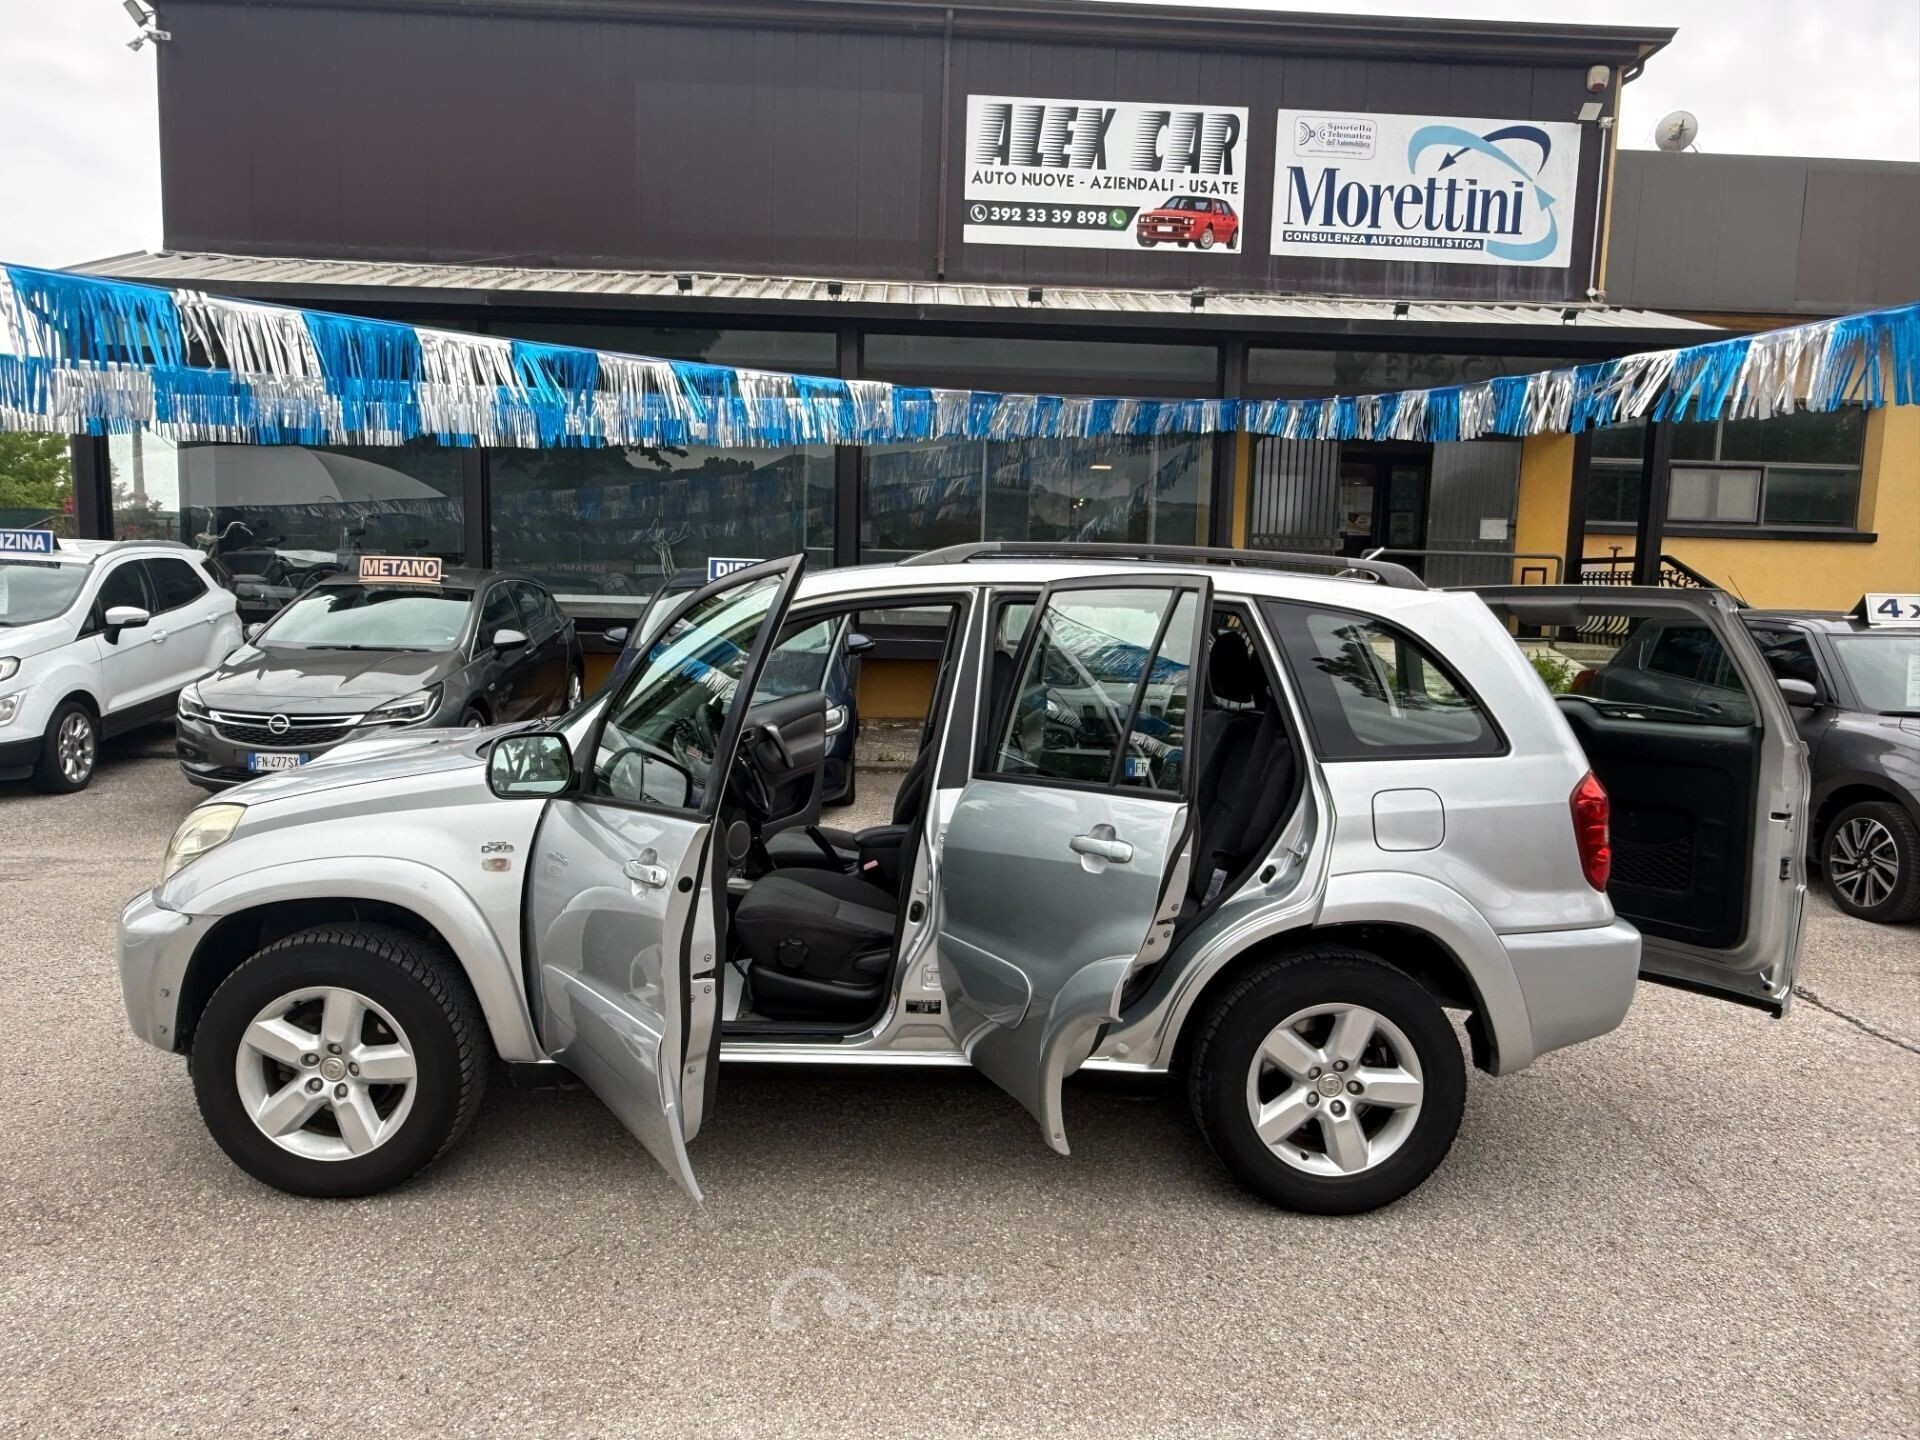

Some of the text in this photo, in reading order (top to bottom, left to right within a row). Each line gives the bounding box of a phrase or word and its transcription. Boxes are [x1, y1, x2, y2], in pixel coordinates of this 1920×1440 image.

[1327, 122, 1372, 132] Sportello
[1327, 131, 1372, 140] Telematico
[975, 103, 1241, 176] ALEX CAR
[971, 170, 1017, 185] AUTO
[1021, 172, 1075, 187] NUOVE
[1090, 175, 1174, 192] AZIENDALI
[1188, 179, 1239, 195] USATE
[1282, 166, 1525, 236] Morettini
[990, 206, 1108, 225] 392 33 39 898
[1285, 231, 1482, 249] CONSULENZA AUTOMOBILISTICA
[363, 559, 438, 577] METANO
